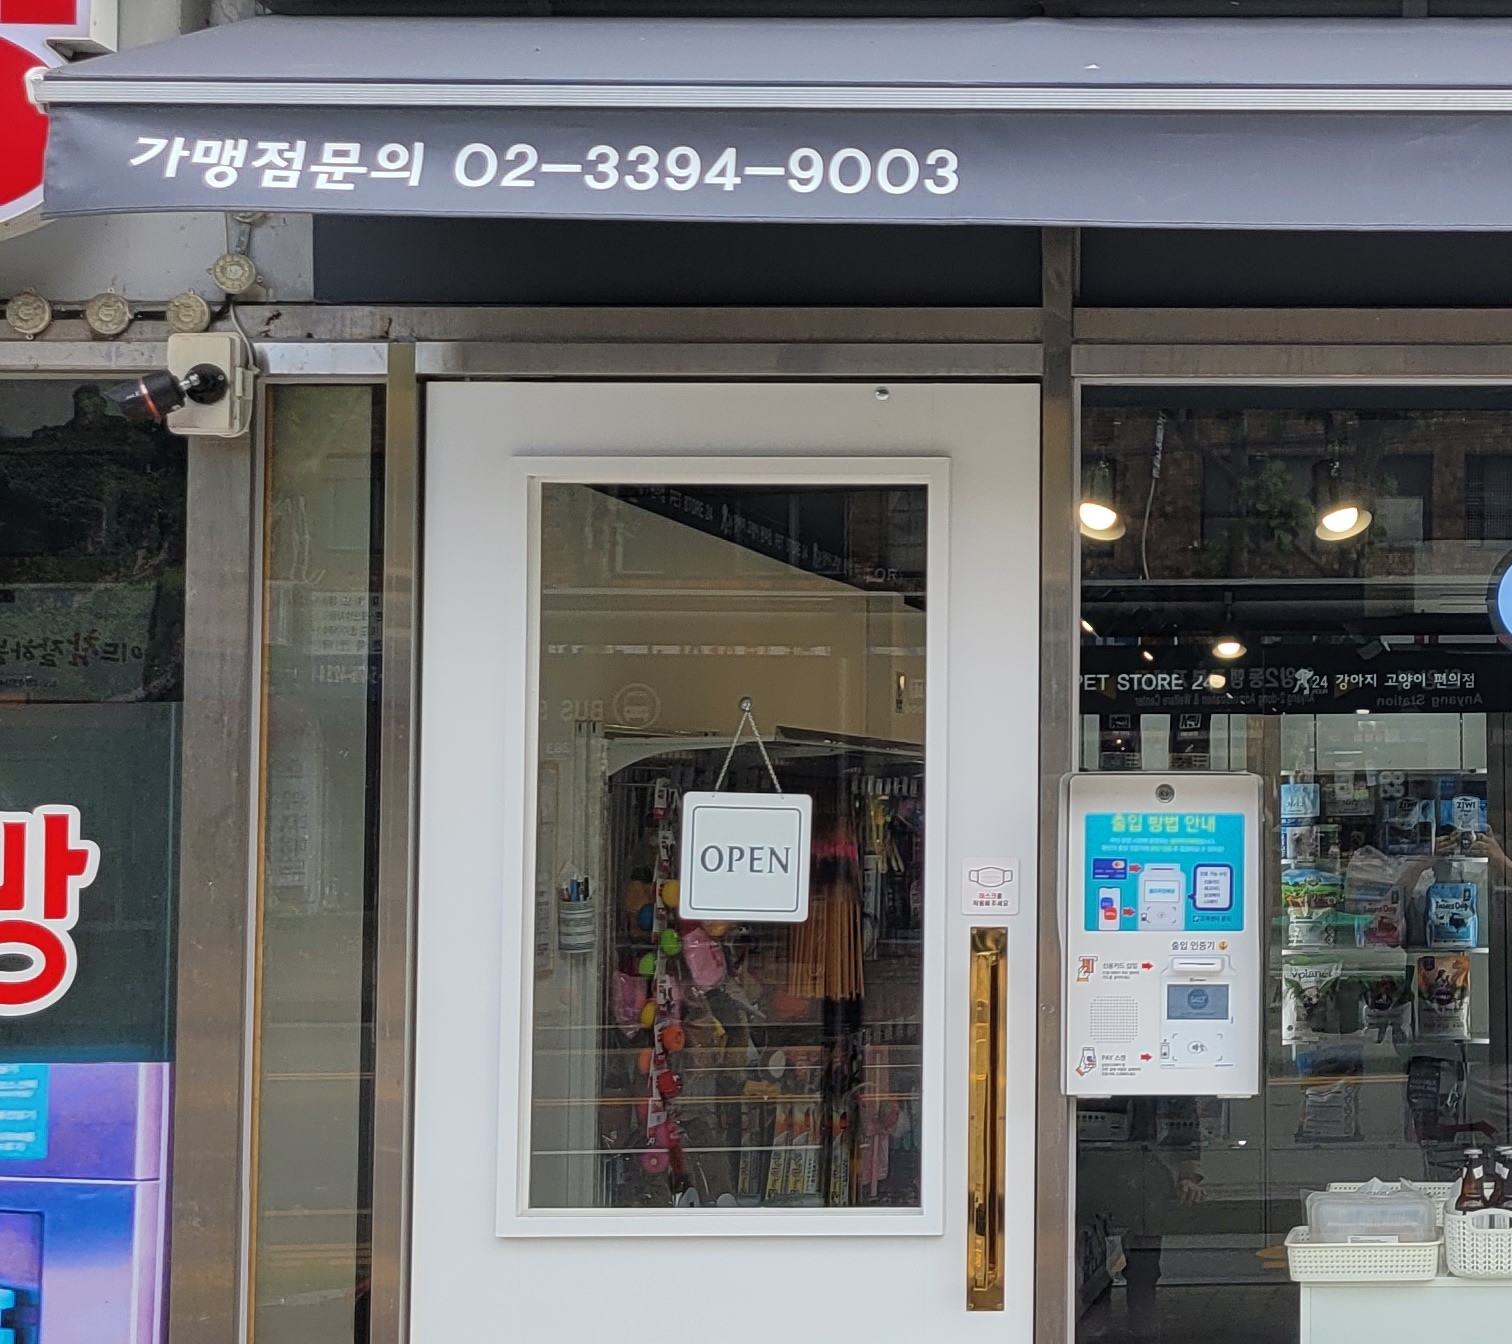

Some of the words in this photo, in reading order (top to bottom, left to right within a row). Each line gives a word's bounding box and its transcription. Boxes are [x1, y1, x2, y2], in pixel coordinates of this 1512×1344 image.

[128, 135, 425, 190] 가맹점문의
[454, 142, 961, 195] 02-3394-9003
[1117, 674, 1184, 691] STORE
[1335, 674, 1377, 690] 강아지
[1384, 673, 1426, 689] 고양이
[1433, 673, 1476, 689] 편의점
[1112, 813, 1142, 833] 출입
[1148, 815, 1179, 832] 방법
[1185, 815, 1217, 833] 안내
[700, 845, 791, 874] OPEN
